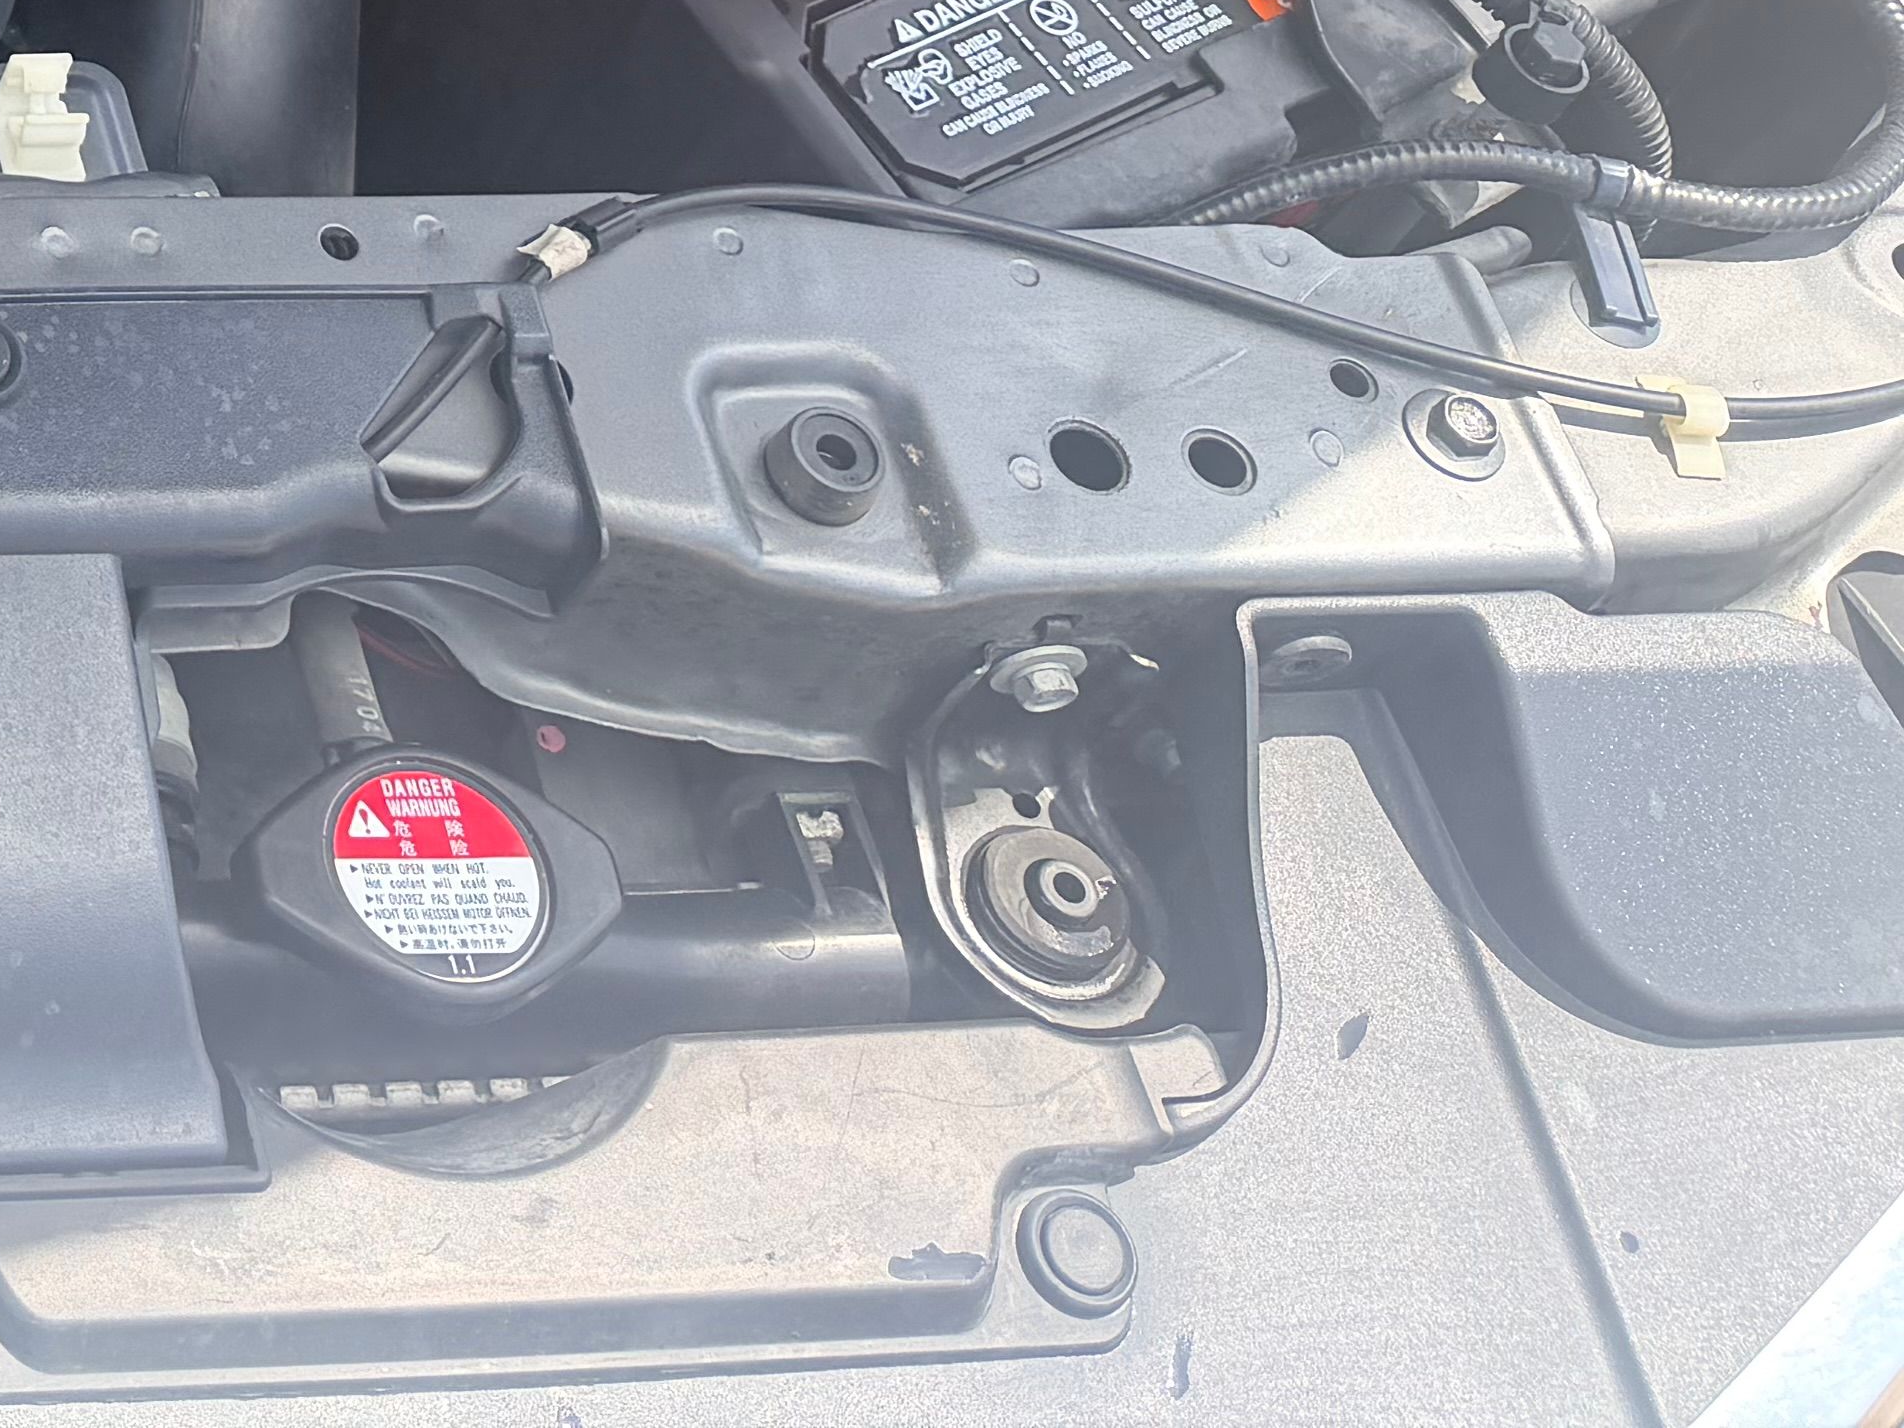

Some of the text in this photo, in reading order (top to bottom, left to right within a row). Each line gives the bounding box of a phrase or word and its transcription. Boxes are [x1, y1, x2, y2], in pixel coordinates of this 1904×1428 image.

[1141, 14, 1165, 31] CAN
[953, 28, 1003, 58] SHIELD
[1061, 31, 1087, 50] NO
[965, 46, 1004, 72] EYES
[948, 56, 1022, 98] EXPLOSIVE
[960, 81, 1008, 110] GASES
[942, 116, 967, 136] CAN
[380, 778, 456, 798] DANGER
[385, 799, 461, 818] WARNUNG
[361, 862, 490, 875] NEVER OPEN WHEN HOT.
[432, 877, 452, 889] will
[460, 878, 487, 889] scald
[494, 879, 516, 891] you.
[388, 894, 426, 906] OUVREZ
[431, 894, 450, 905] PAS
[454, 893, 489, 905] QUAND
[423, 908, 460, 920] HEISSEN
[447, 954, 477, 975] 1.1
